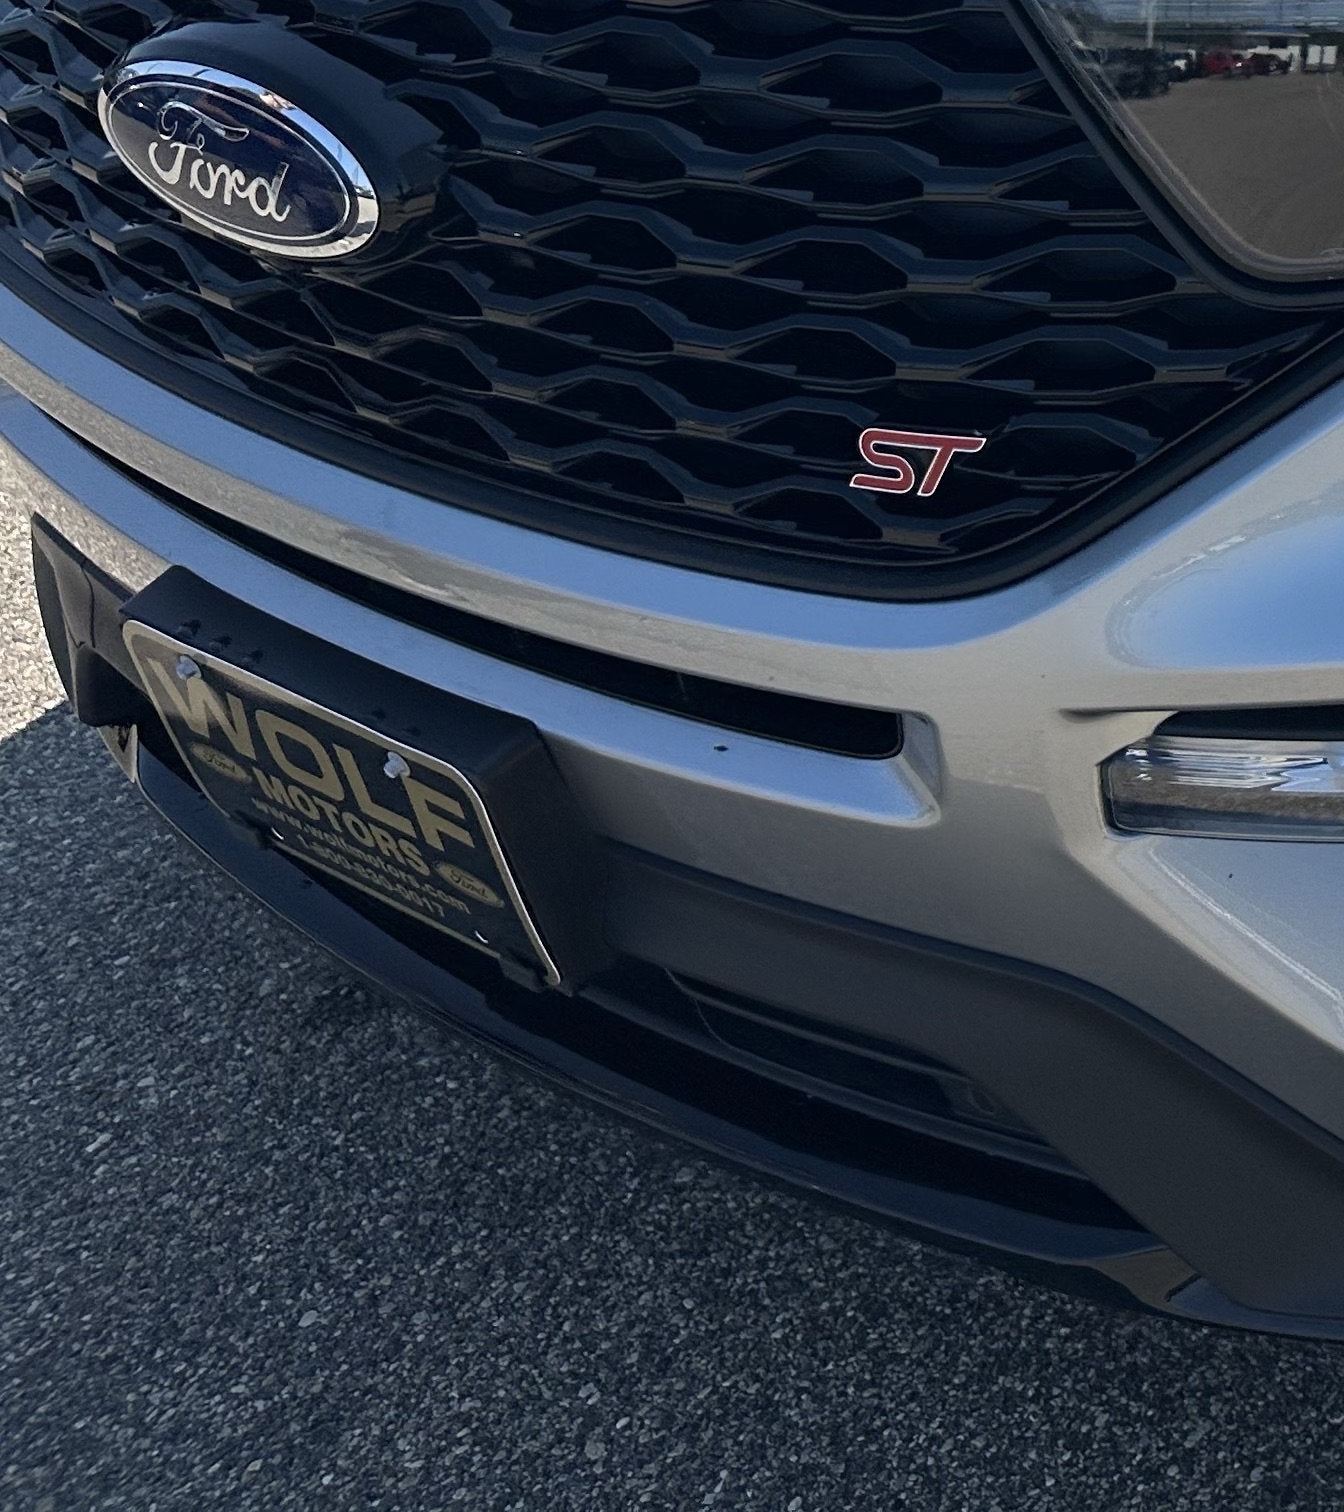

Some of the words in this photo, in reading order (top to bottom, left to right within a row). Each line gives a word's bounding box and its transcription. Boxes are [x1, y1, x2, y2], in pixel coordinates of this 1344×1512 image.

[149, 101, 291, 224] Ford
[848, 427, 988, 497] ST
[146, 655, 475, 853] WOLF
[251, 765, 431, 877] MOTORS
[449, 869, 489, 899] Ford
